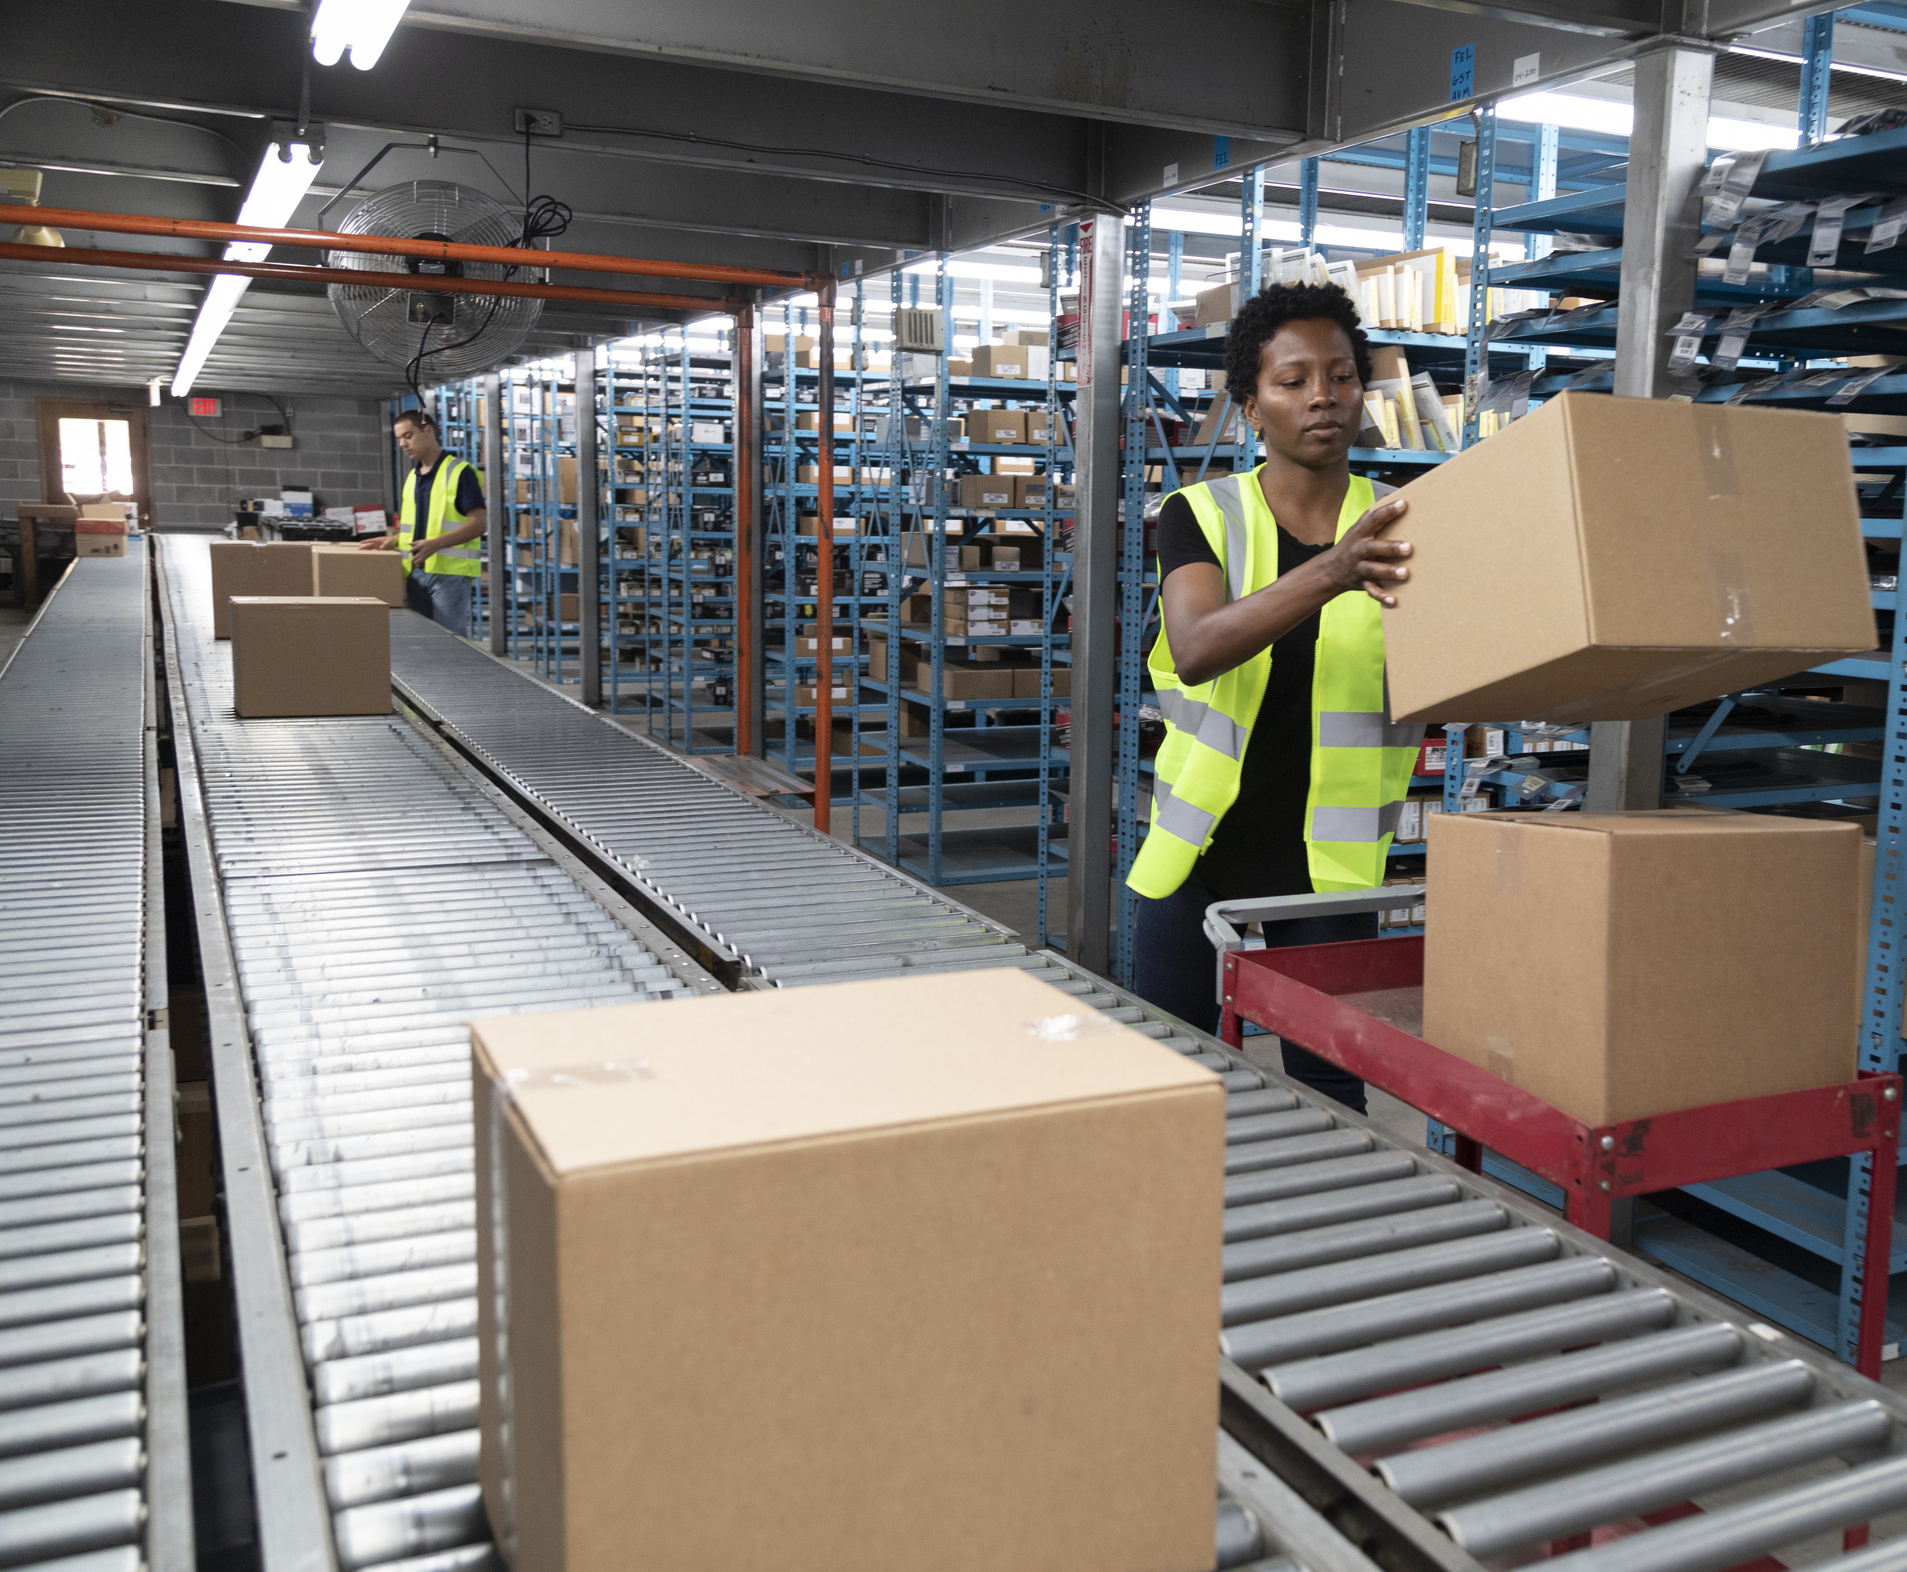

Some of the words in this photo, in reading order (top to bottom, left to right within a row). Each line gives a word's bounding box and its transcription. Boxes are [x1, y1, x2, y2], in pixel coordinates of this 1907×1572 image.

[1455, 48, 1472, 64] FEL
[1452, 70, 1471, 86] GST
[1451, 87, 1470, 101] AVM
[1215, 152, 1229, 166] FEL
[1080, 235, 1092, 256] FIRE
[193, 397, 216, 415] EXIT
